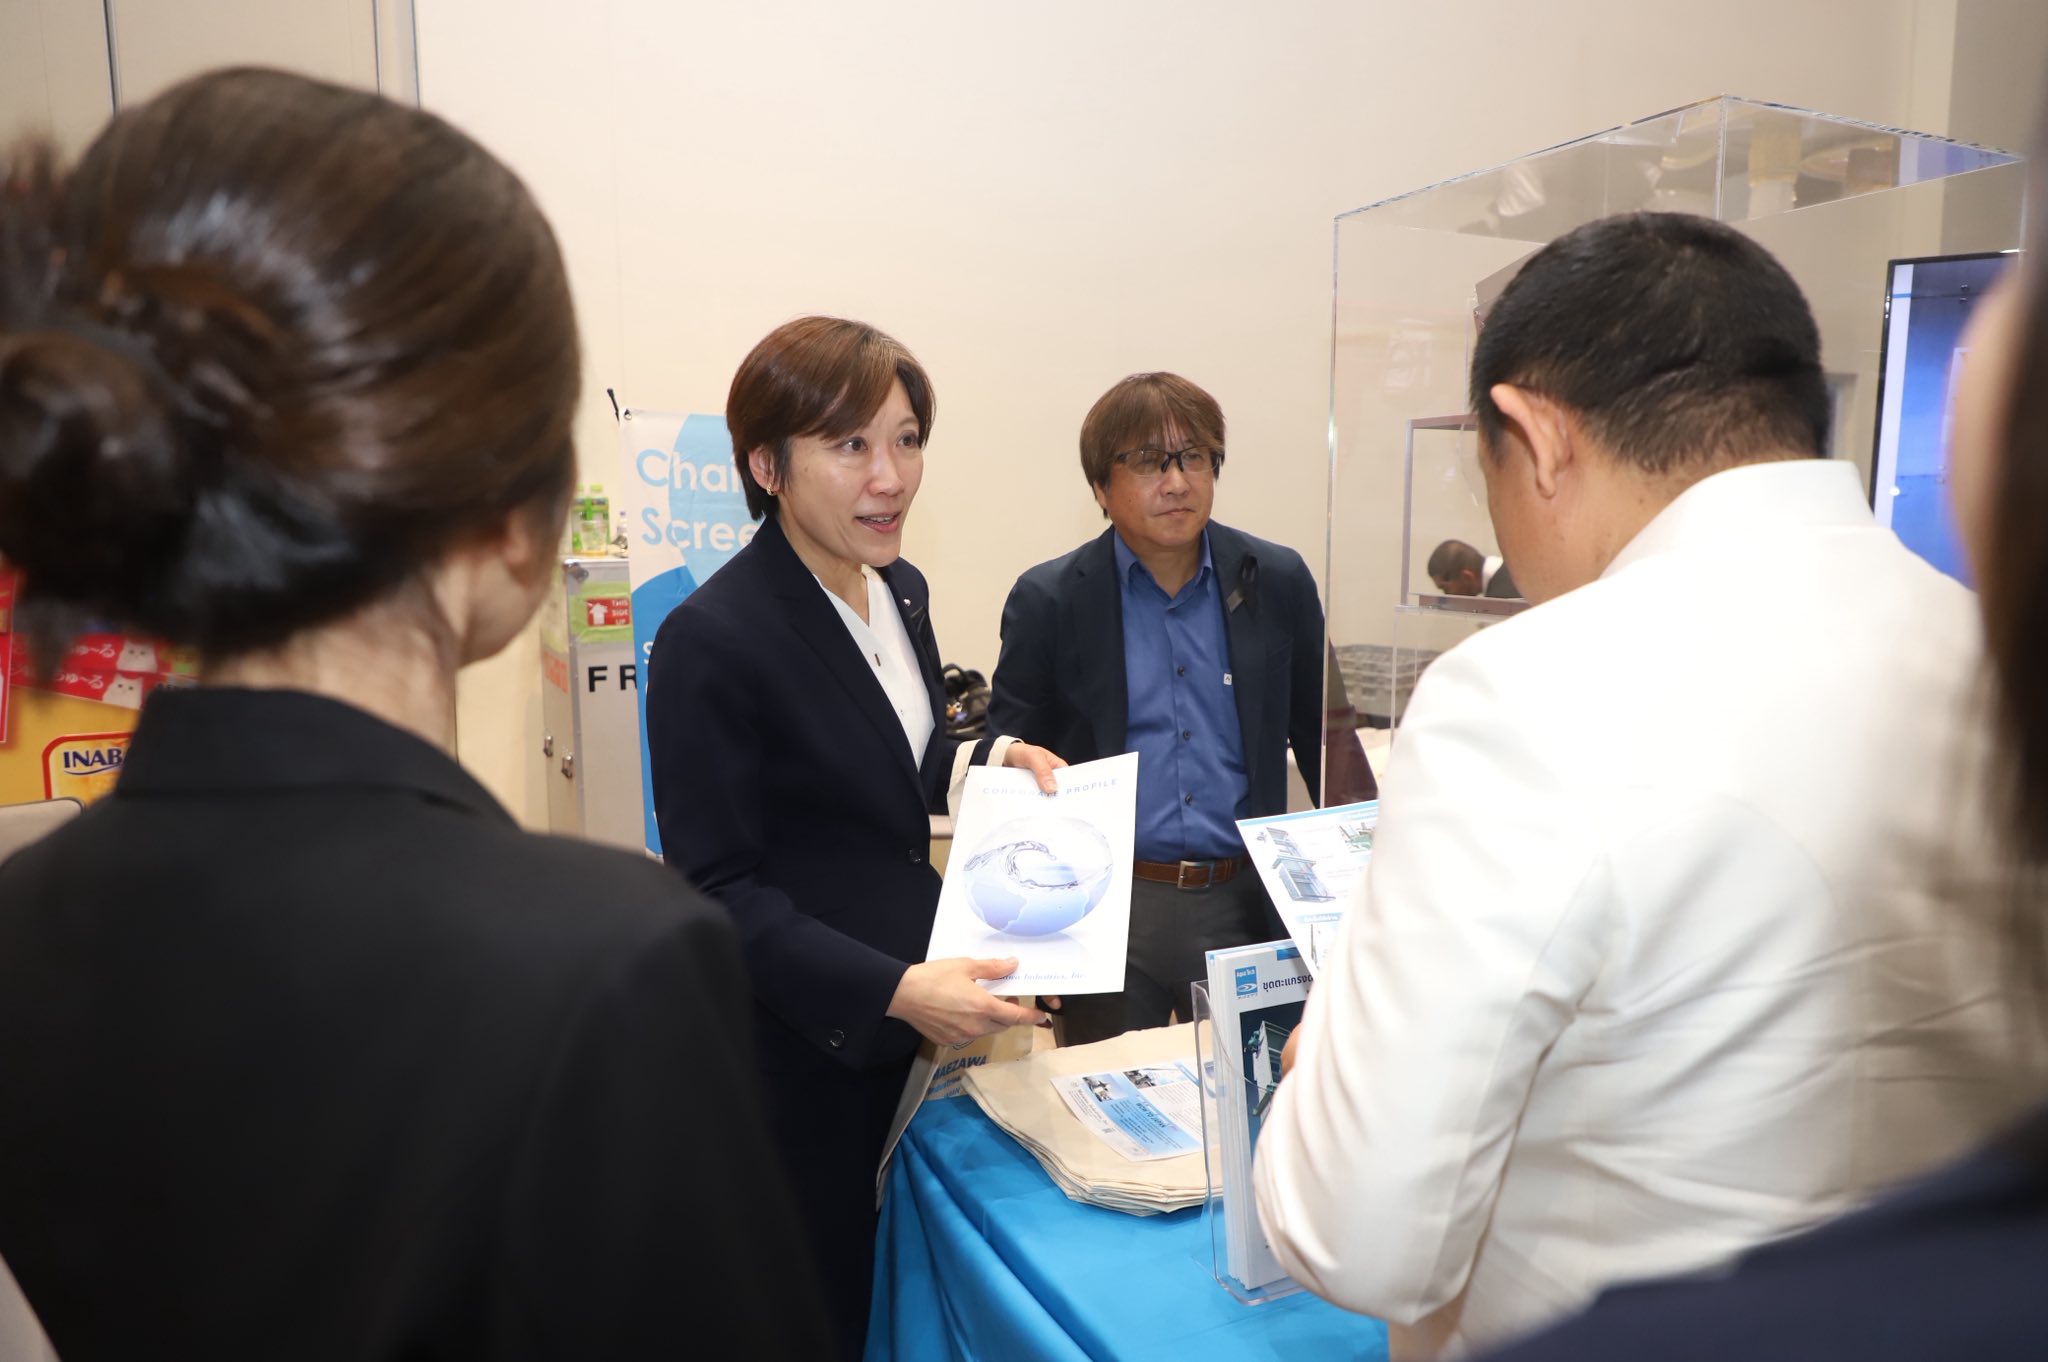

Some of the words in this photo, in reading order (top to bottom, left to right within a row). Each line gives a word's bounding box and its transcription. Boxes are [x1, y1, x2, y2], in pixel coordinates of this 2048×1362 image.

[611, 600, 629, 608] THIS
[611, 608, 630, 617] SIDE
[615, 617, 627, 626] UP
[1066, 779, 1118, 795] PROFILE
